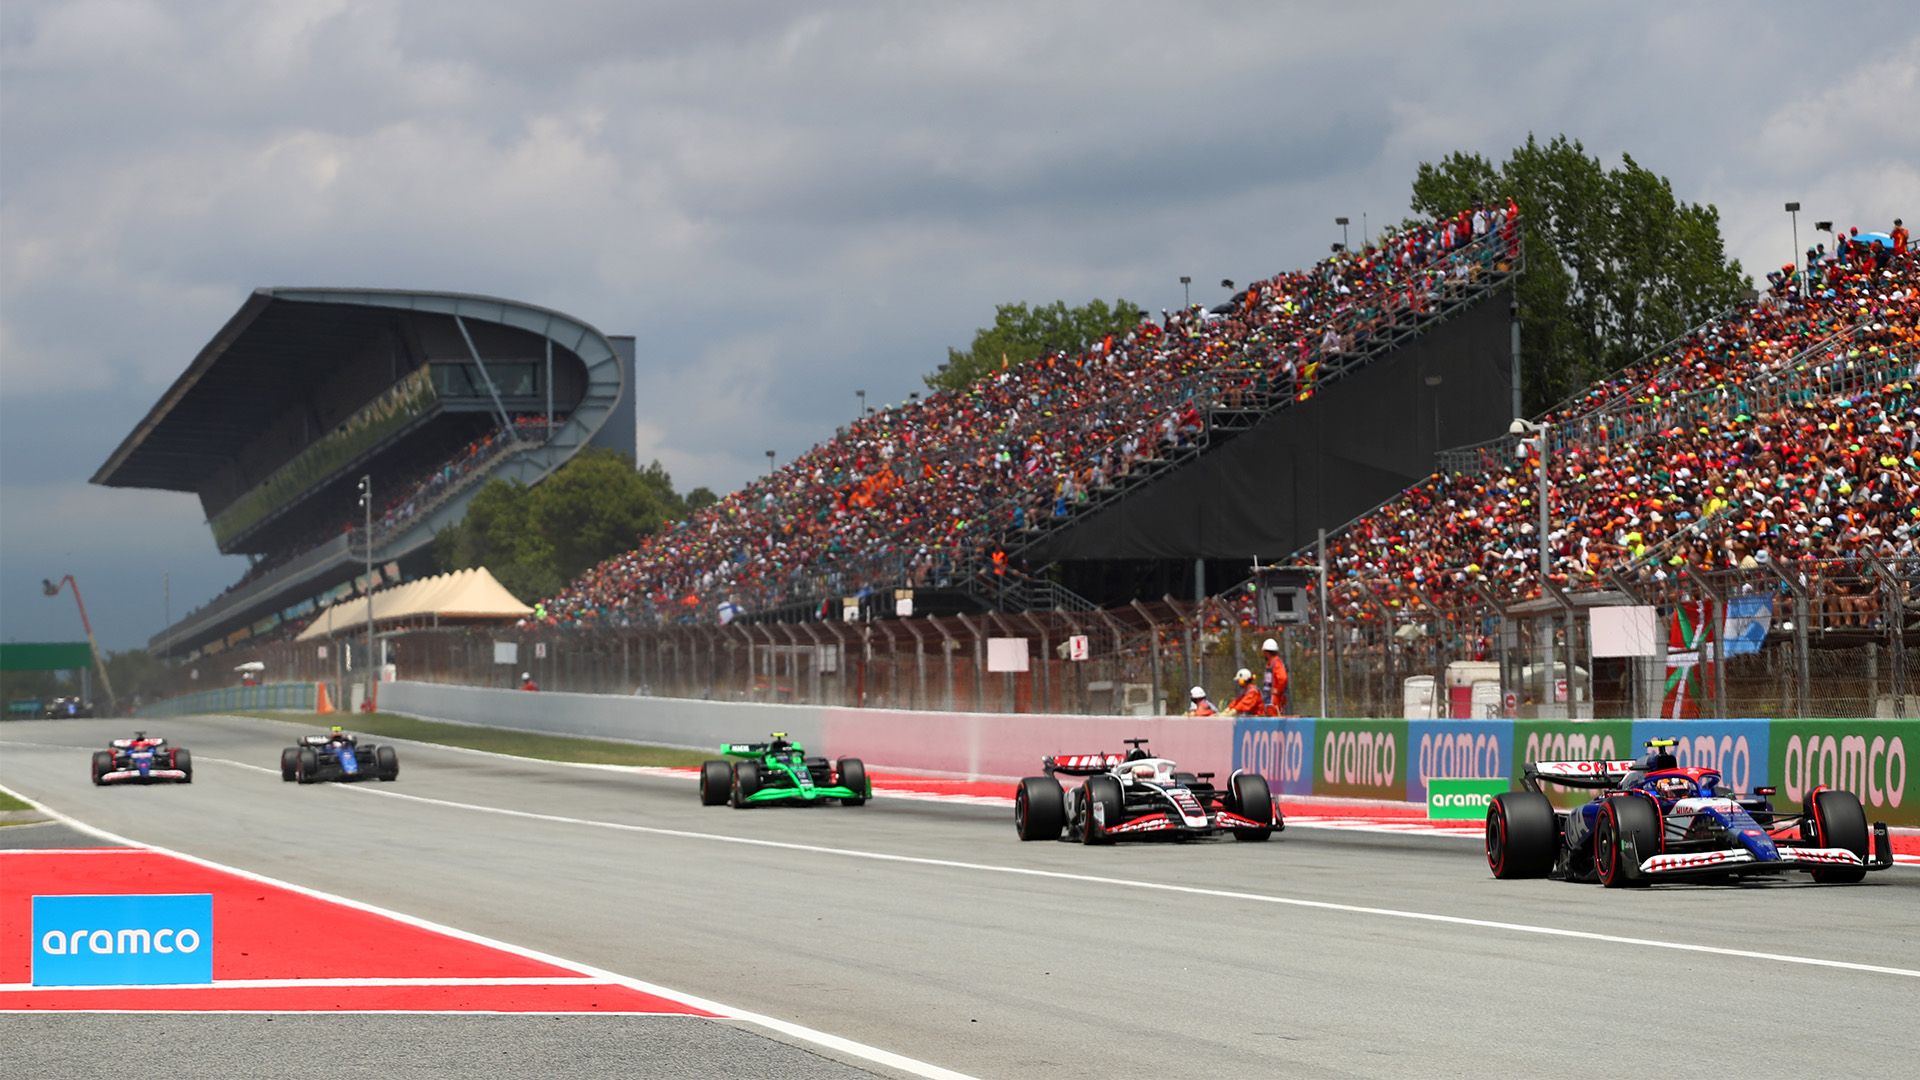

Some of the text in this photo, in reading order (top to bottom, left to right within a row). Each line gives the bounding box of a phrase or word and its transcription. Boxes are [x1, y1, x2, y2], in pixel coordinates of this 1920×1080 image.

[1241, 730, 1303, 782] aramco
[1323, 731, 1396, 787] aramco
[1419, 733, 1500, 788] aramco
[1577, 762, 1630, 774] ORLE
[1784, 734, 1906, 808] aramco
[1432, 793, 1493, 807] aramc
[1651, 852, 1726, 872] HUGO
[42, 928, 201, 955] aramco
